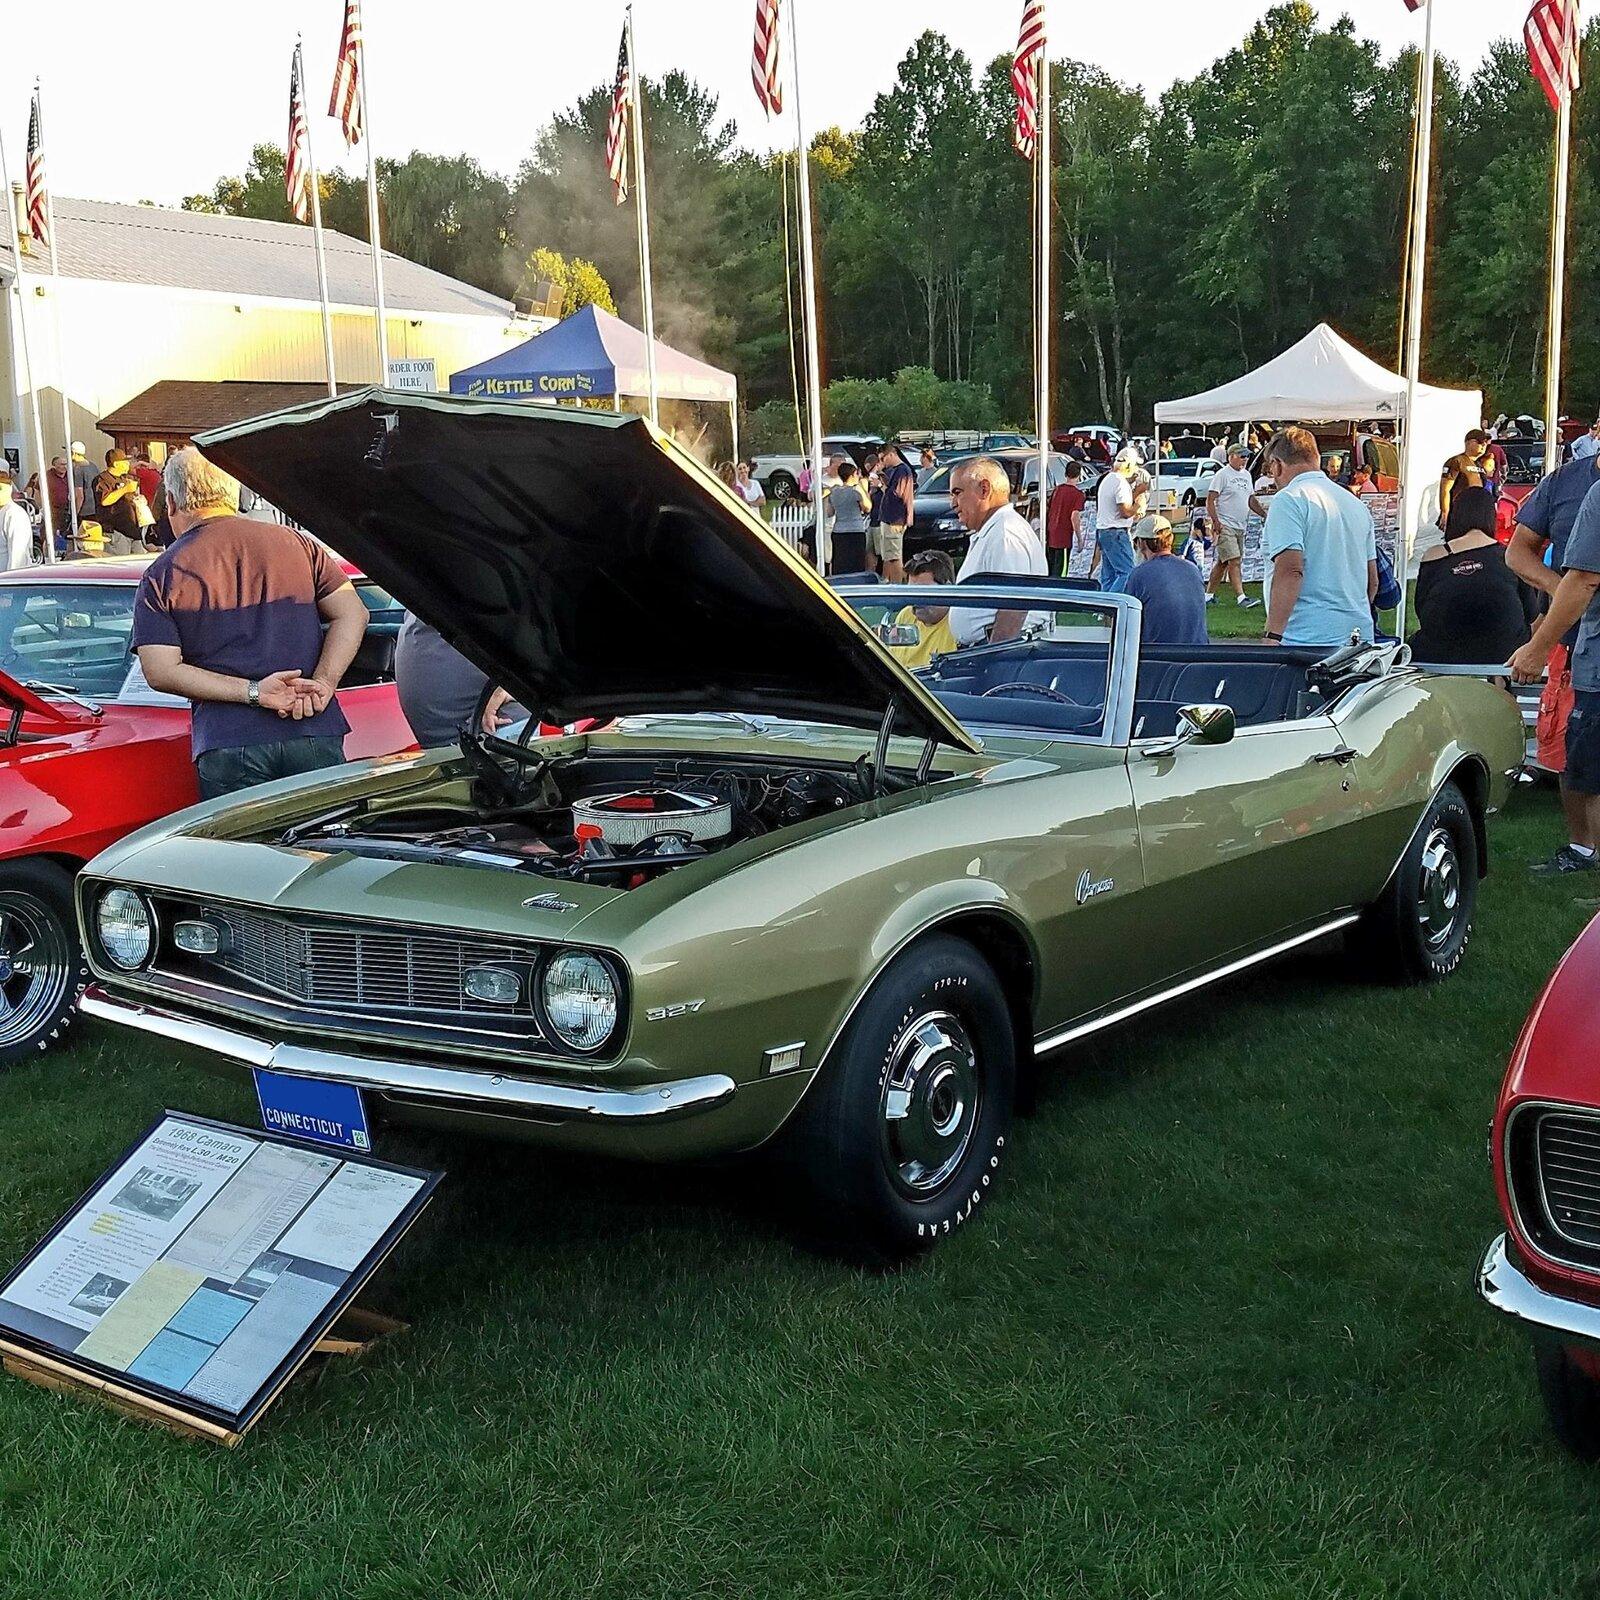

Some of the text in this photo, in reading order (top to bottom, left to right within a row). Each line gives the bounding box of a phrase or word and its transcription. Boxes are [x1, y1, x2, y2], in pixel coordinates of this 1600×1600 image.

[389, 361, 434, 373] RDER FOOD
[400, 377, 422, 387] HERE
[486, 378, 535, 395] KETTLE
[539, 375, 576, 392] CORN
[37, 938, 89, 1050] OODYEAR
[934, 976, 968, 991] F70-14
[646, 998, 706, 1021] 327
[266, 1107, 343, 1138] CONNECTICUT
[168, 1128, 242, 1154] 1968 Camaro
[190, 1146, 211, 1157] L30
[216, 1153, 240, 1164] M20
[917, 1136, 1005, 1237] GOODYEAR
